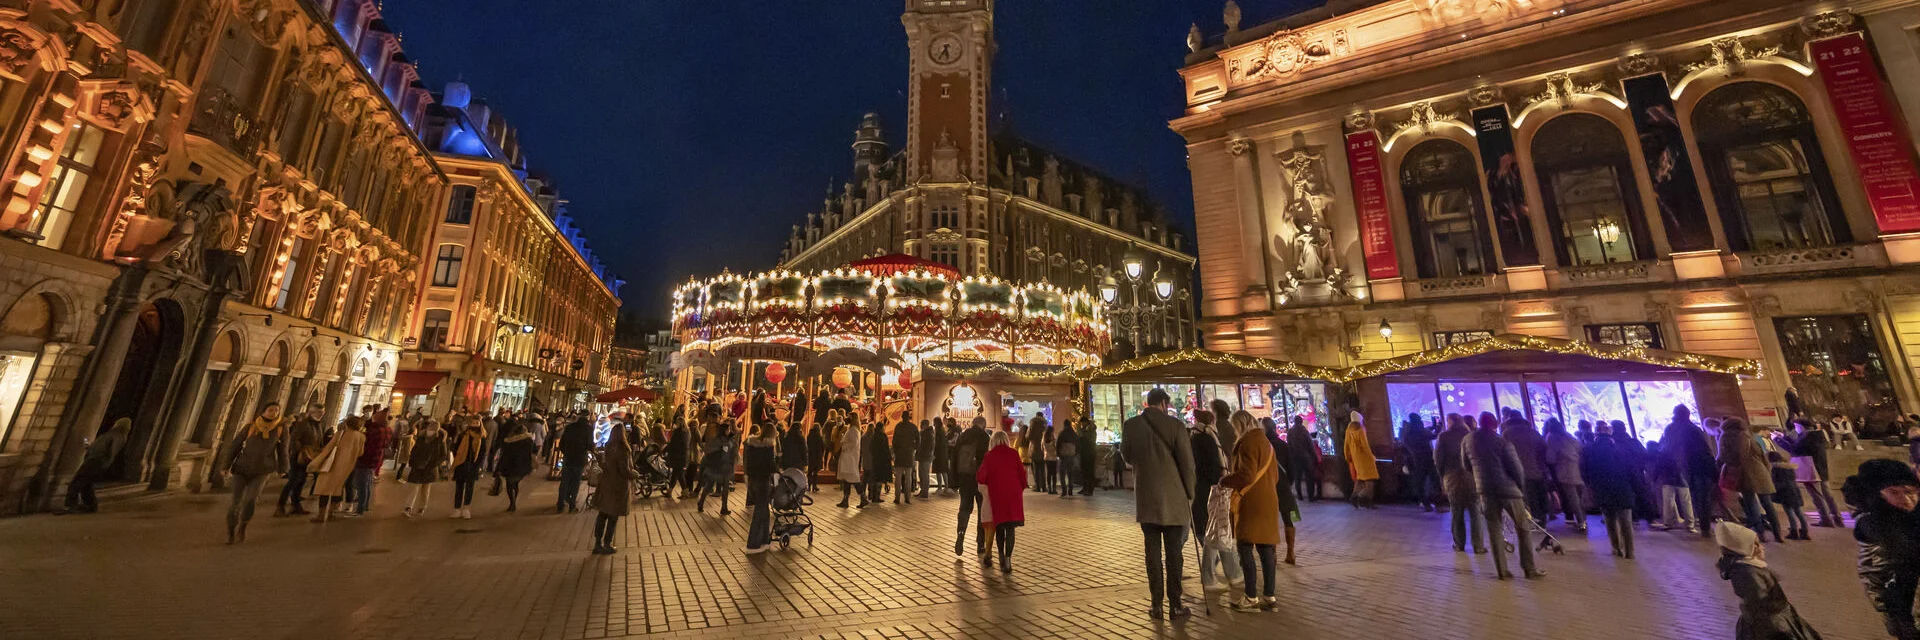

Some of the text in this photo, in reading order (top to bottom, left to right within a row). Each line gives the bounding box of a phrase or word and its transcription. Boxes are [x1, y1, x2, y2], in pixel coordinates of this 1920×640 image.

[1820, 46, 1862, 61] 21 22
[759, 345, 810, 362] CHENILLE
